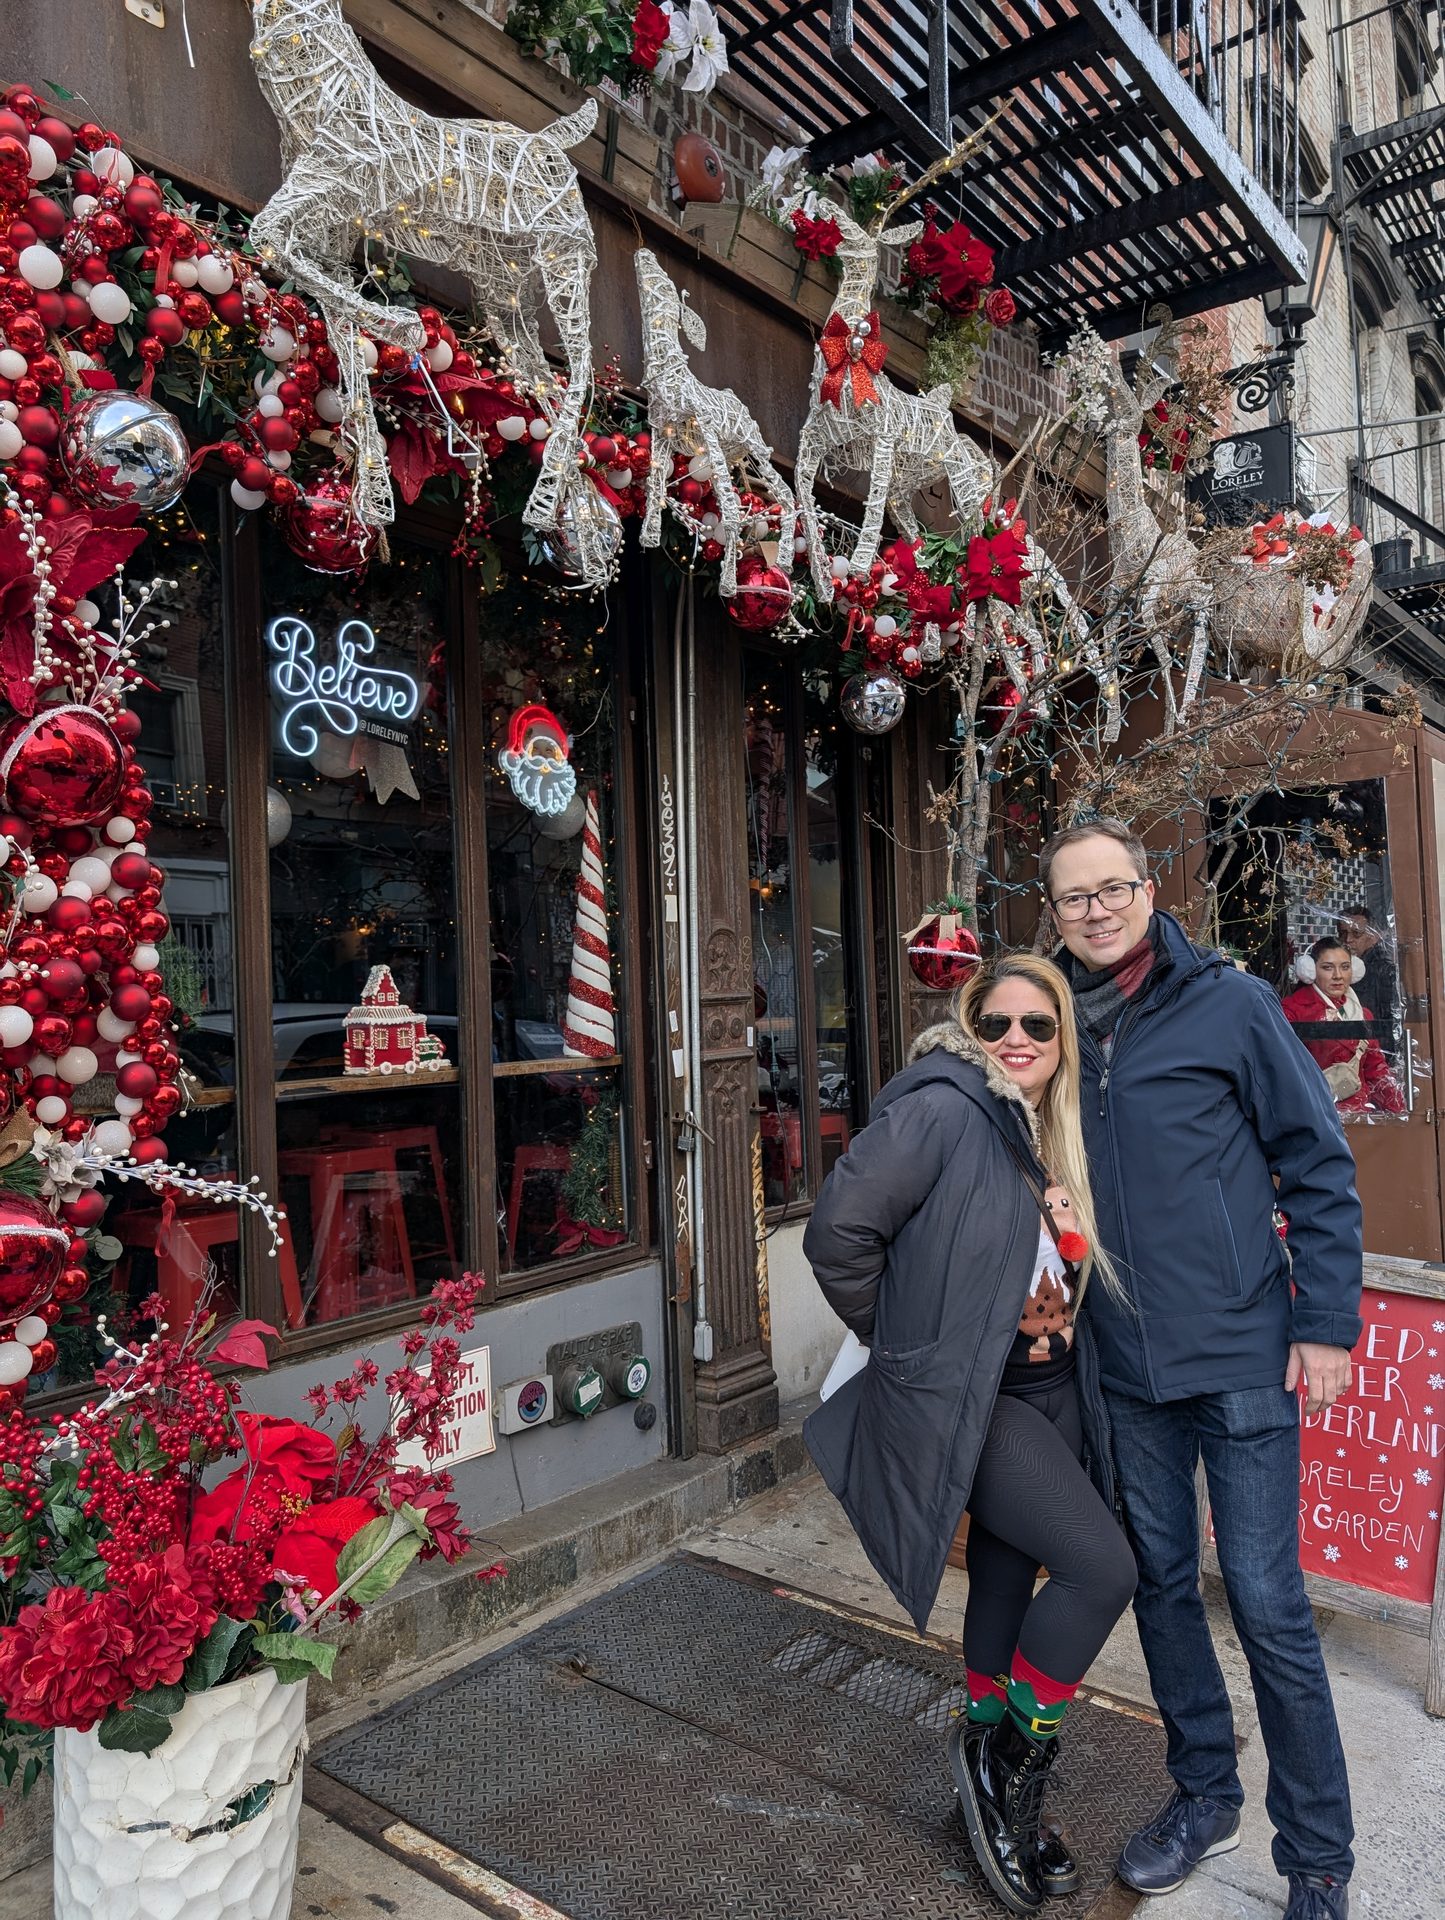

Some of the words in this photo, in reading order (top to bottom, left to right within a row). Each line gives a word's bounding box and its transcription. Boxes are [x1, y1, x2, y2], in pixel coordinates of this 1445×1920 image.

[1211, 470, 1265, 491] LORELEY
[270, 616, 419, 757] Believe
[561, 1335, 595, 1361] AUTO
[1366, 1324, 1425, 1363] ED
[450, 1361, 479, 1391] EPT.
[425, 1427, 462, 1462] ONLY
[1299, 1460, 1403, 1513] RELEY
